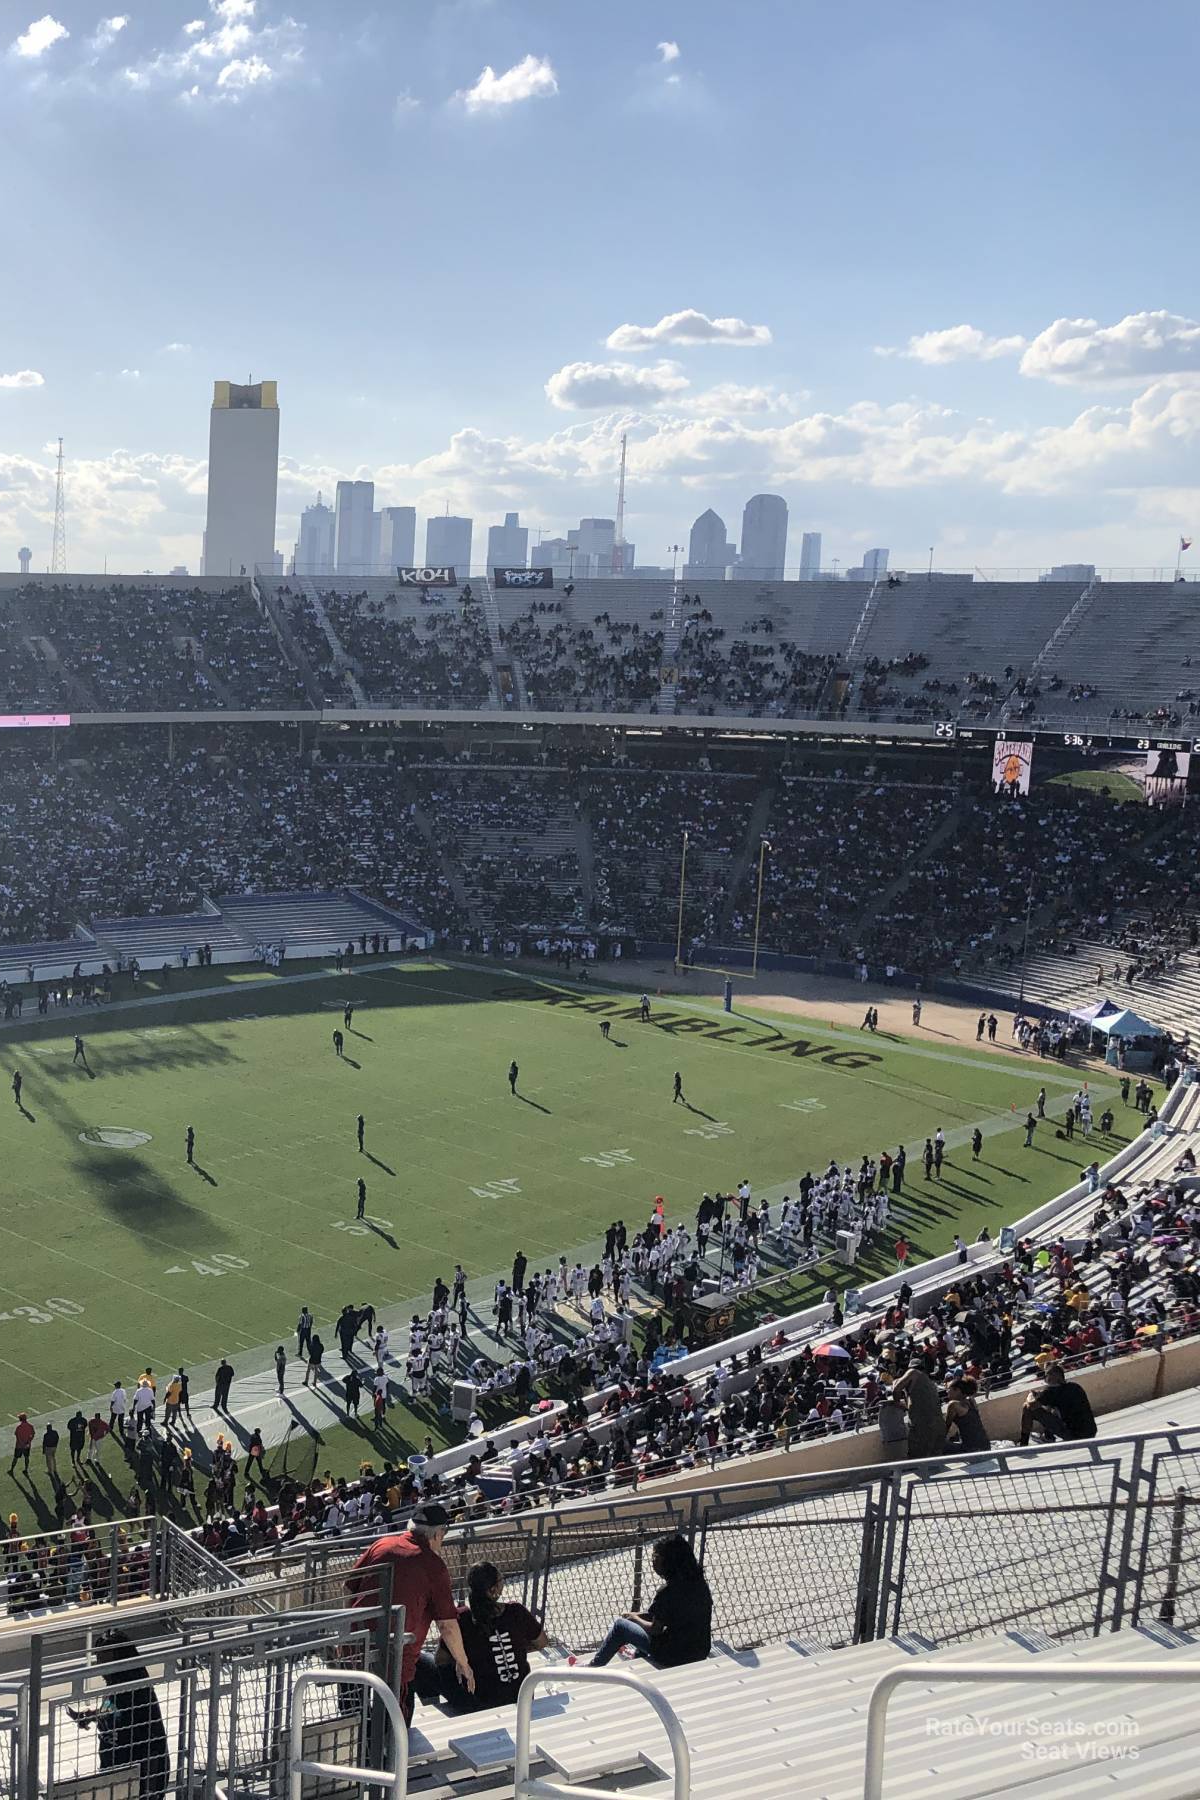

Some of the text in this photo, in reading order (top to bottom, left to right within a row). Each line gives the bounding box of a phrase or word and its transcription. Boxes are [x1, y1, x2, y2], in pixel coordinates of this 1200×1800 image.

[936, 723, 953, 736] 25
[1137, 740, 1150, 749] 23
[492, 986, 883, 1069] GRAMBLING
[468, 1180, 522, 1199] 40
[191, 1253, 250, 1276] 40
[11, 1297, 85, 1324] 30
